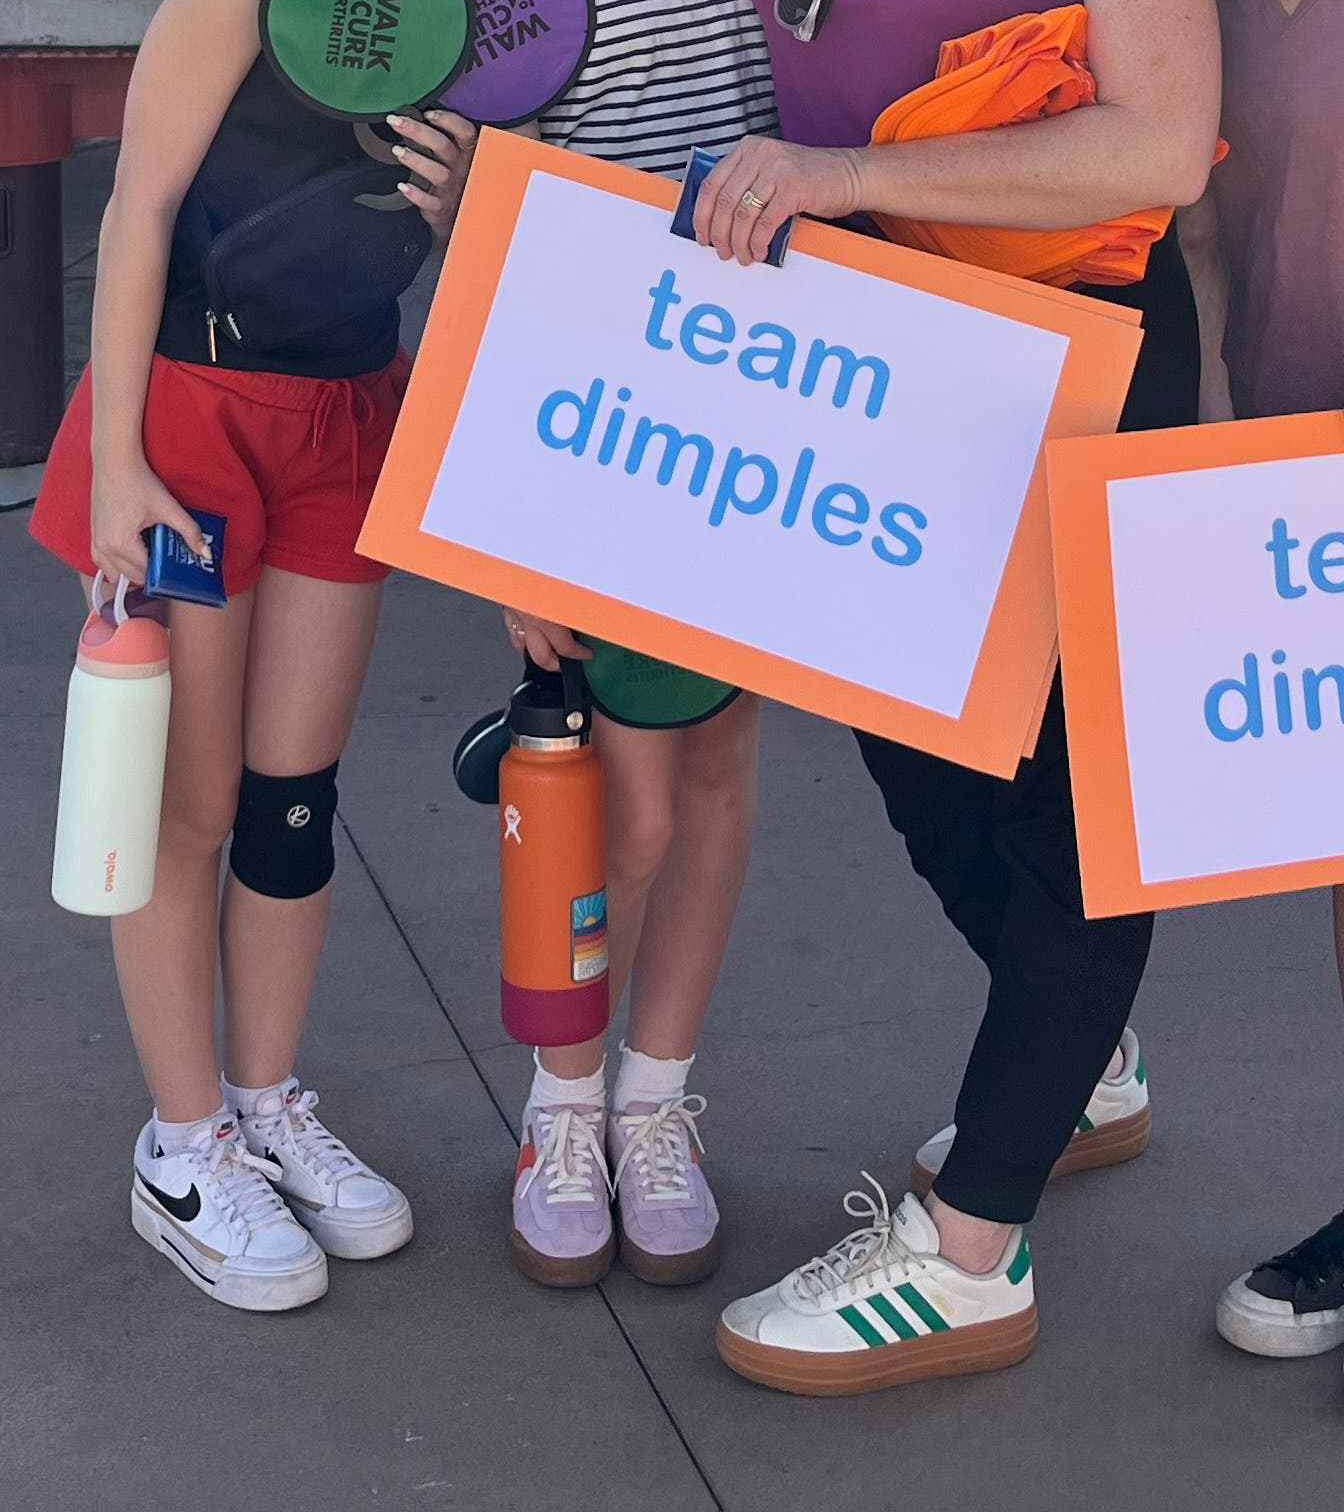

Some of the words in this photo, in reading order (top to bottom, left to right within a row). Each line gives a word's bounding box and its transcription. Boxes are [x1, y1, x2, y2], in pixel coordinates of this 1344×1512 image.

[474, 4, 513, 38] CU
[643, 269, 891, 420] team
[536, 377, 929, 568] dimples
